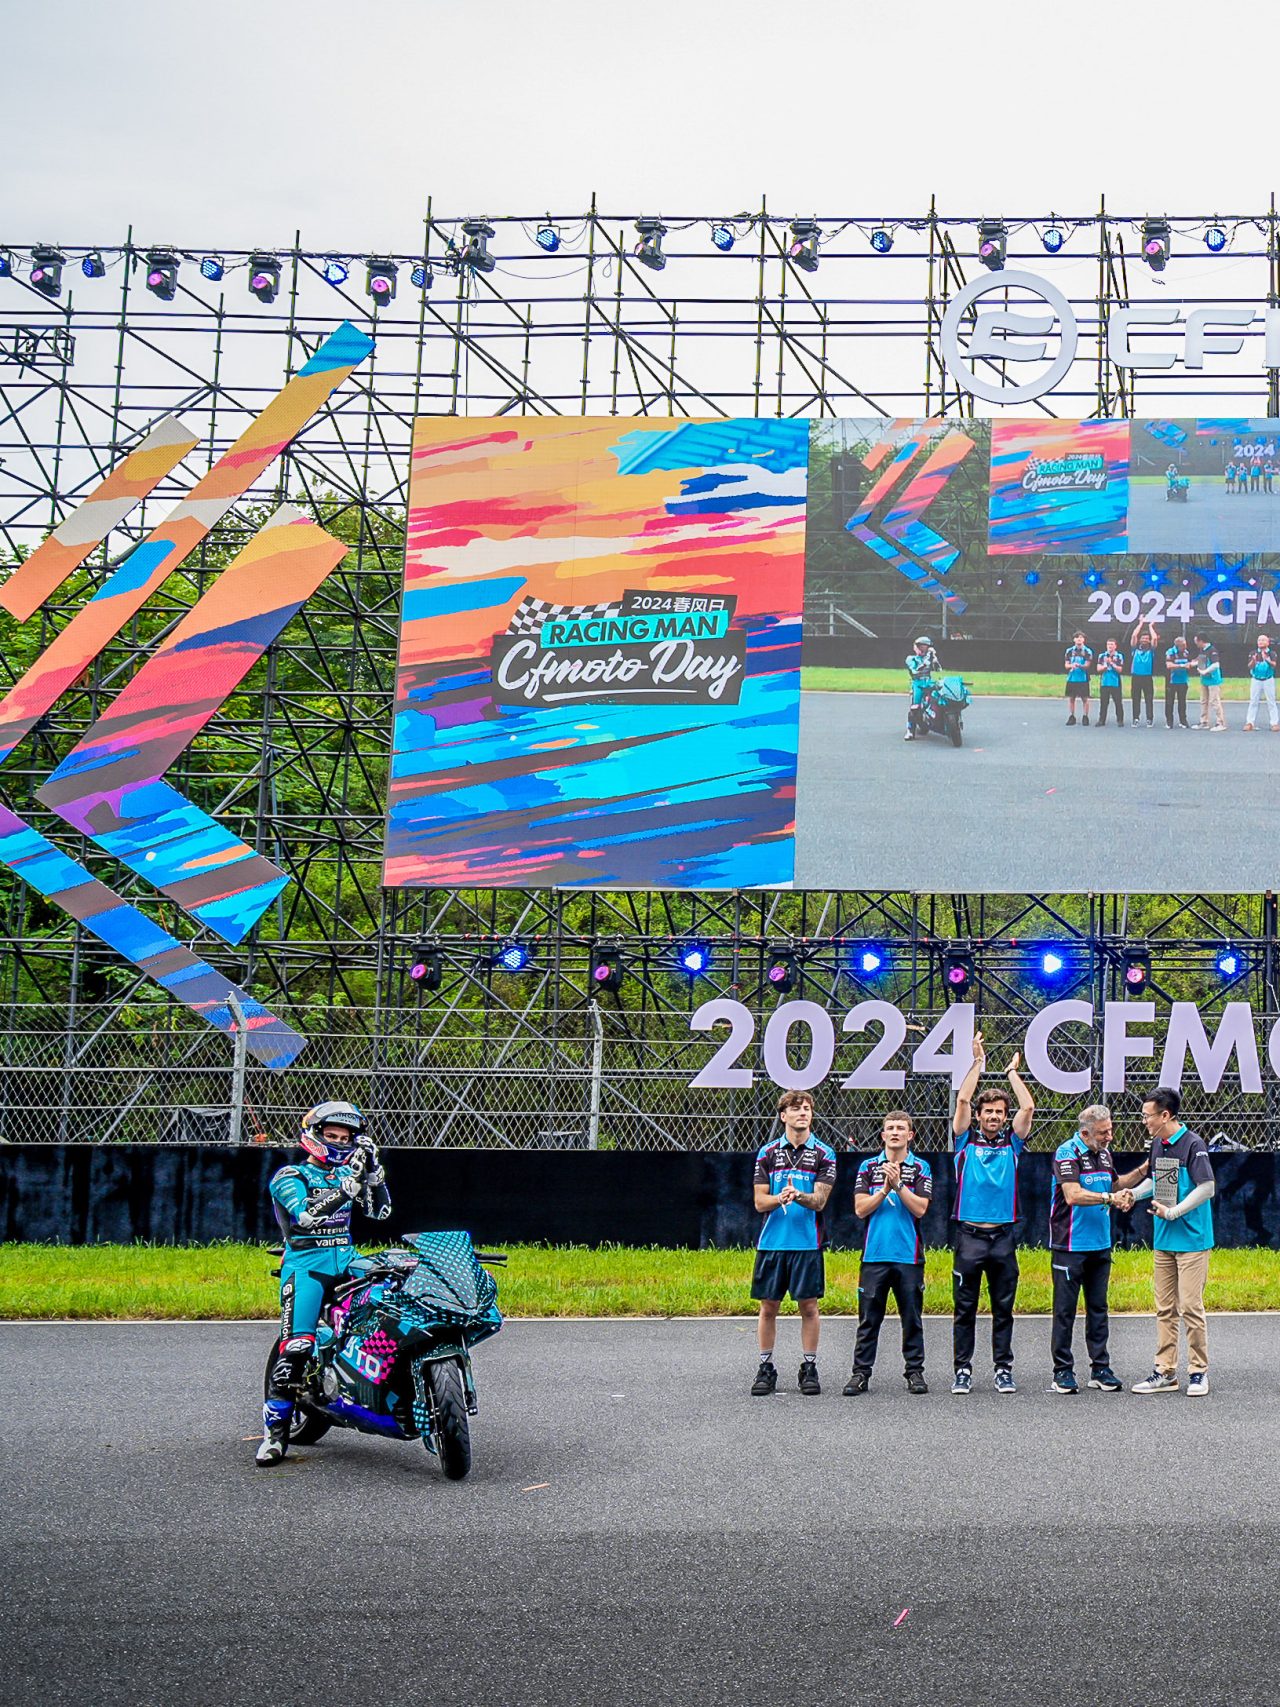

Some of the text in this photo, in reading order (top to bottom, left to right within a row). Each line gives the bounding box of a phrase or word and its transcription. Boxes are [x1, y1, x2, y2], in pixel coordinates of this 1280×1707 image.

[1234, 444, 1275, 457] 2024
[1087, 590, 1194, 624] 2024
[550, 615, 719, 644] RACING MAN
[497, 639, 743, 700] Cfmoto Day
[688, 999, 985, 1090] 2024
